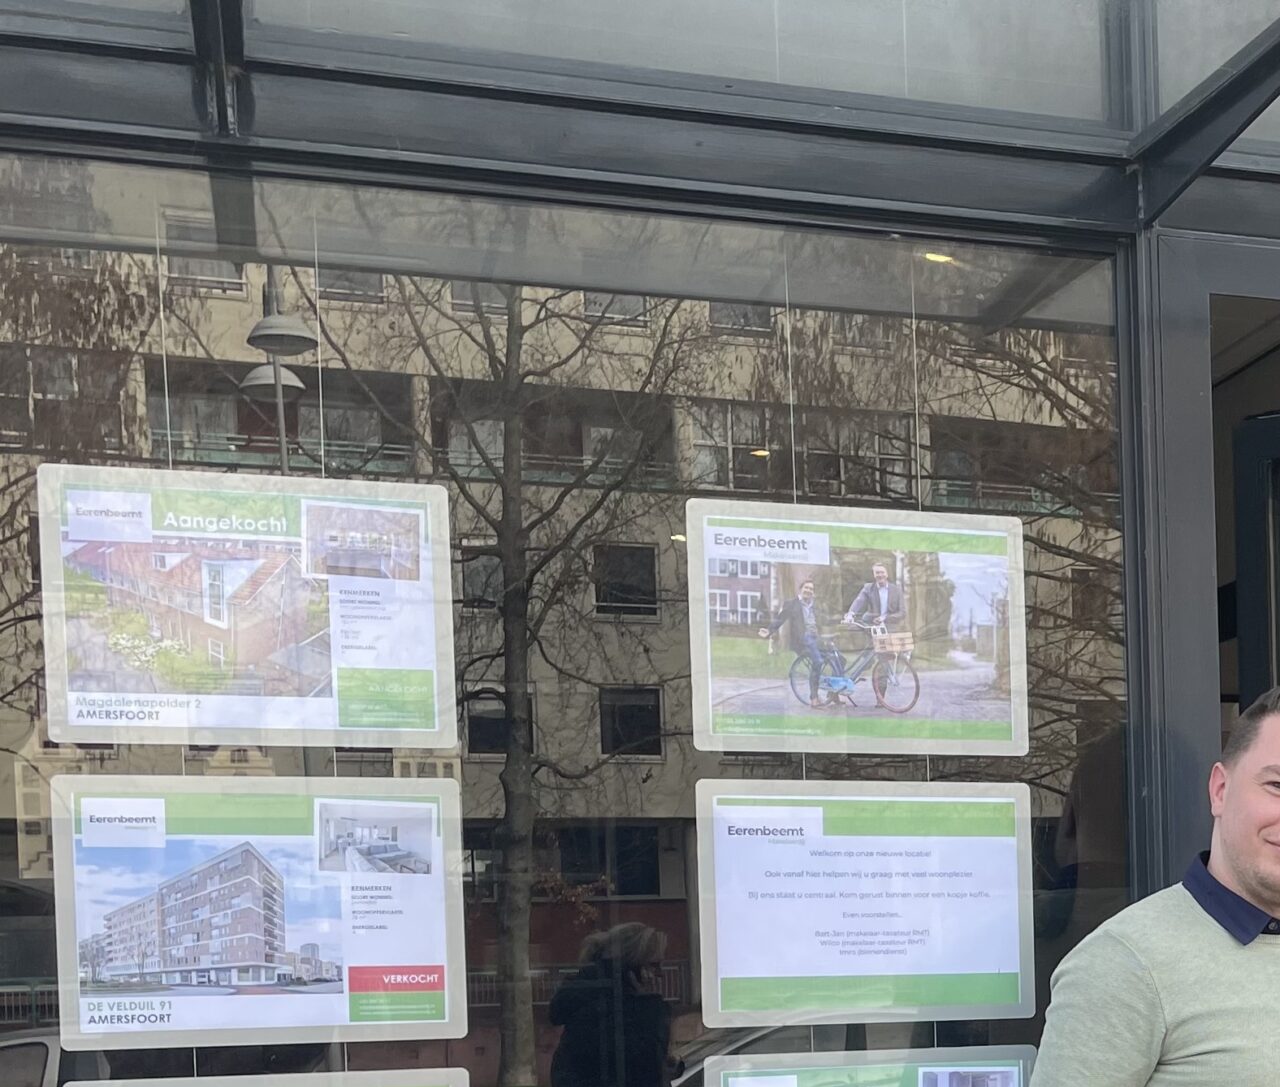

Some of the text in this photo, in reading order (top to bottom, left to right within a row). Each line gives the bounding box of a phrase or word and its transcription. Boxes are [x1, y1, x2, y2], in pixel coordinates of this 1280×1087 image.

[713, 532, 808, 550] Eerenbeemt
[76, 709, 161, 721] AMERSFOORT
[89, 814, 157, 824] Eerenbeemt
[728, 825, 805, 837] Eerenbeemt
[383, 974, 439, 984] VERKOCHT
[87, 1000, 172, 1012] DE VELDUIL 91
[87, 1013, 172, 1025] AMERSFOORT
